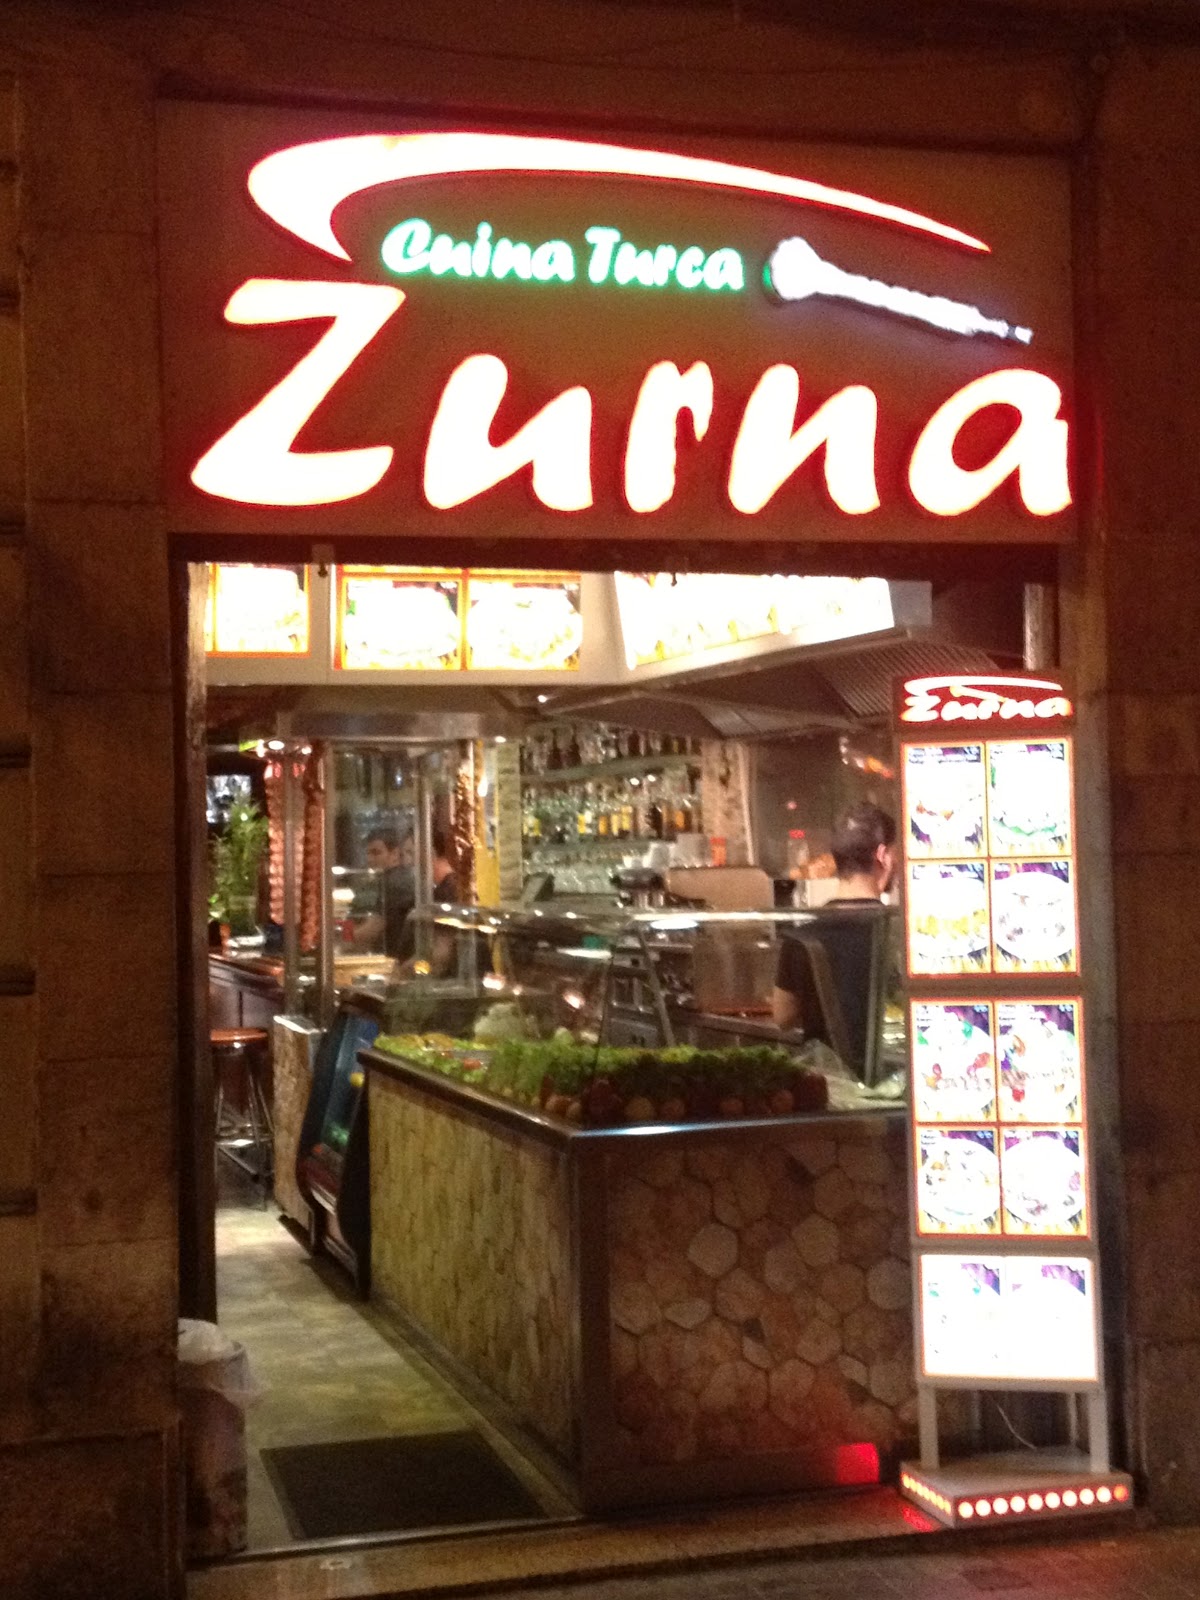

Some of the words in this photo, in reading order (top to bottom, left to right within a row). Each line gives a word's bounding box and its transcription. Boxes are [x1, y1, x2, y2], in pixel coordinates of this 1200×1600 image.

[380, 217, 576, 283] Cuina
[583, 225, 746, 292] Turca
[190, 277, 1073, 517] Zurna
[901, 696, 1072, 721] Zurna
